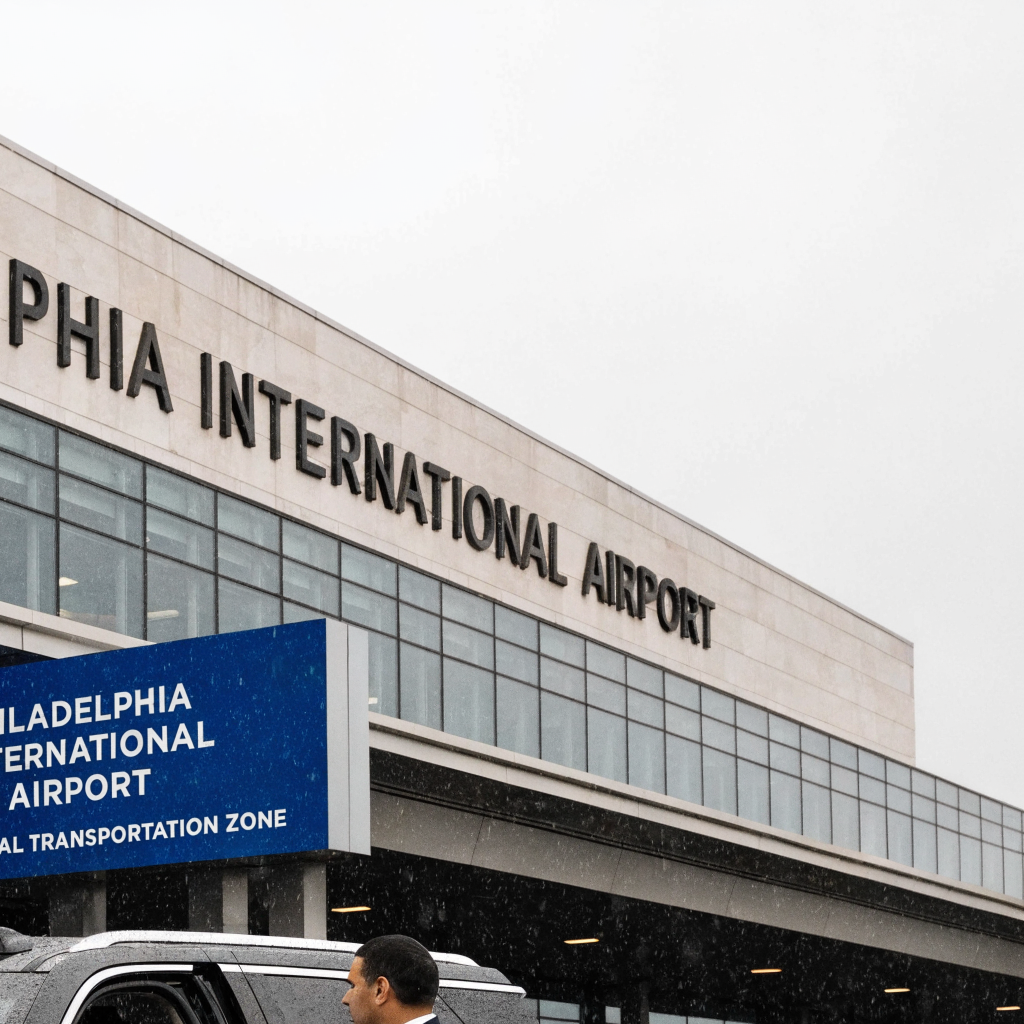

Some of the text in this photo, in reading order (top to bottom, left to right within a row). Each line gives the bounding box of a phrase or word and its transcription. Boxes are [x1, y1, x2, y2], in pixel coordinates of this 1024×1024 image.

[200, 351, 568, 588] INTERNATIONAL
[581, 541, 716, 650] AIRPORT
[8, 768, 152, 811] AIRPORT
[28, 815, 218, 852] TRANSPORTATION
[225, 808, 287, 834] ZONE
